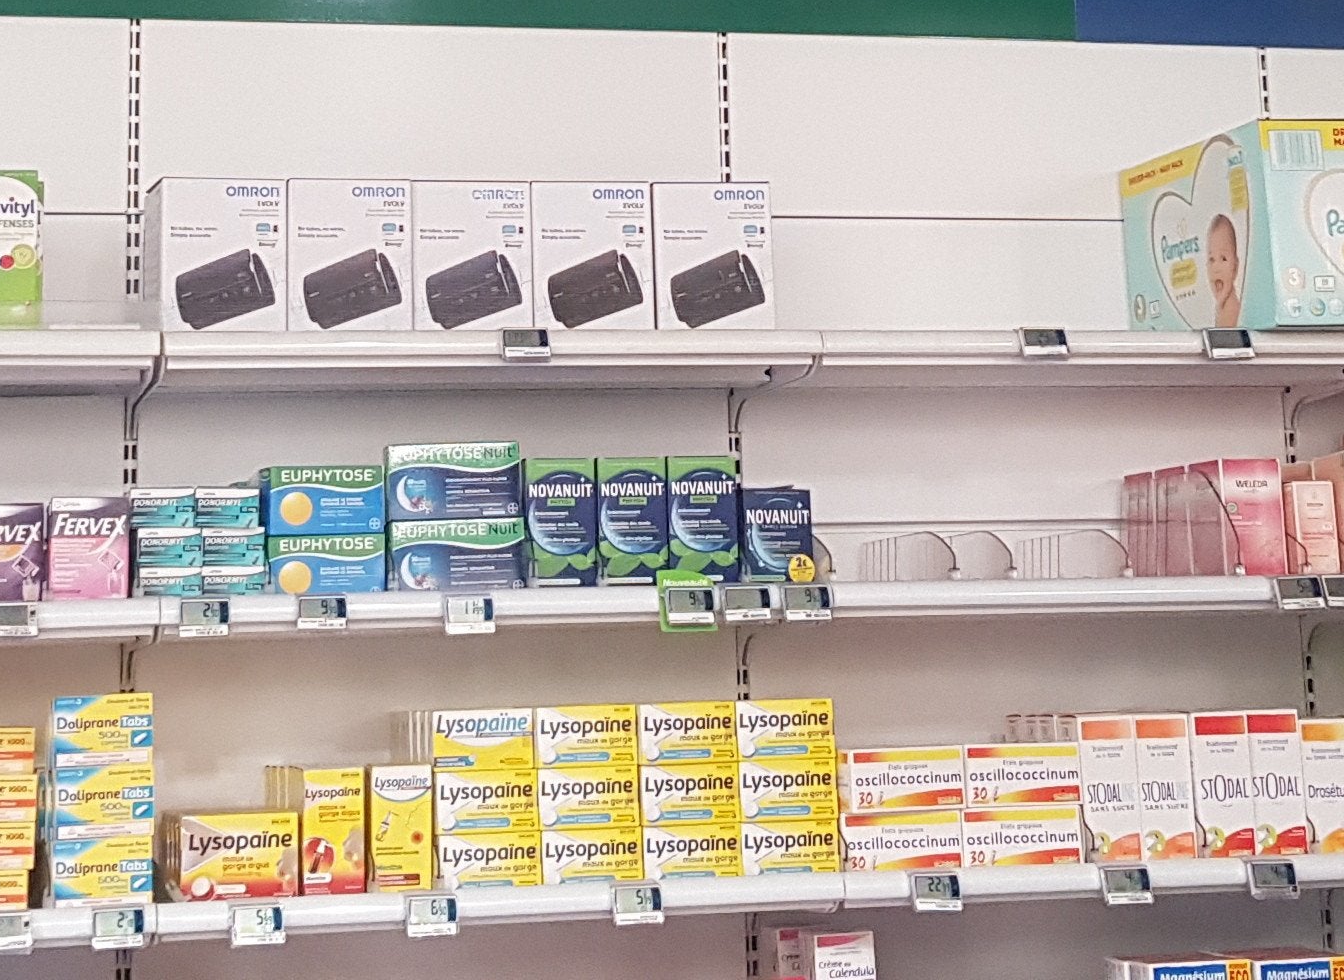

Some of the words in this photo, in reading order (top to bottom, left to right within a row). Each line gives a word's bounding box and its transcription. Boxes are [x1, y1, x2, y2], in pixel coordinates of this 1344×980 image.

[226, 186, 280, 198] OMRON
[352, 186, 405, 198] OMRON
[472, 189, 524, 200] OMRON
[593, 188, 644, 200] OMRON
[714, 189, 765, 201] OMRON
[1160, 234, 1200, 262] Pampers
[281, 469, 376, 482] EUPHYTOSE
[529, 483, 593, 498] NOVANUIT
[601, 482, 664, 497] NOVANUIT
[671, 480, 733, 495] NOVANUIT
[53, 513, 126, 536] FERVEX
[746, 508, 809, 525] NOVANUIT
[279, 537, 377, 551] EUPHYTOSE
[56, 716, 119, 732] Doliprane
[121, 716, 149, 726] Tabs
[436, 713, 529, 738] Lysopaïne
[540, 717, 632, 737] Lysopaïne
[644, 714, 732, 735] Lysopaïne
[739, 710, 829, 732] Lysopaïne
[374, 776, 429, 790] Lysopaïne
[742, 771, 832, 792] Lysopaïne
[855, 771, 961, 787] oscillococcinum
[969, 768, 1078, 782] oscillococcinum
[541, 779, 633, 798] Lysopaïne
[645, 773, 734, 795] Lysopaïne
[1201, 775, 1250, 801] STODAL
[1252, 772, 1301, 799] STODAL
[58, 789, 121, 804] Doliprane
[123, 787, 151, 798] Tabs
[440, 782, 533, 804] Lysopaïne
[858, 793, 873, 805] 30
[973, 788, 988, 799] 30
[188, 832, 294, 856] Lysopaïne
[646, 835, 737, 856] Lysopaïne
[744, 831, 834, 852] Lysopaïne
[847, 836, 959, 850] oscillococcinum
[966, 832, 1078, 846] oscillococcinum
[443, 844, 537, 866] Lysopaïne
[546, 840, 638, 861] Lysopaïne
[970, 851, 985, 864] 30
[56, 862, 118, 877] Doliprane
[120, 860, 148, 871] Tabs
[851, 857, 866, 869] 30
